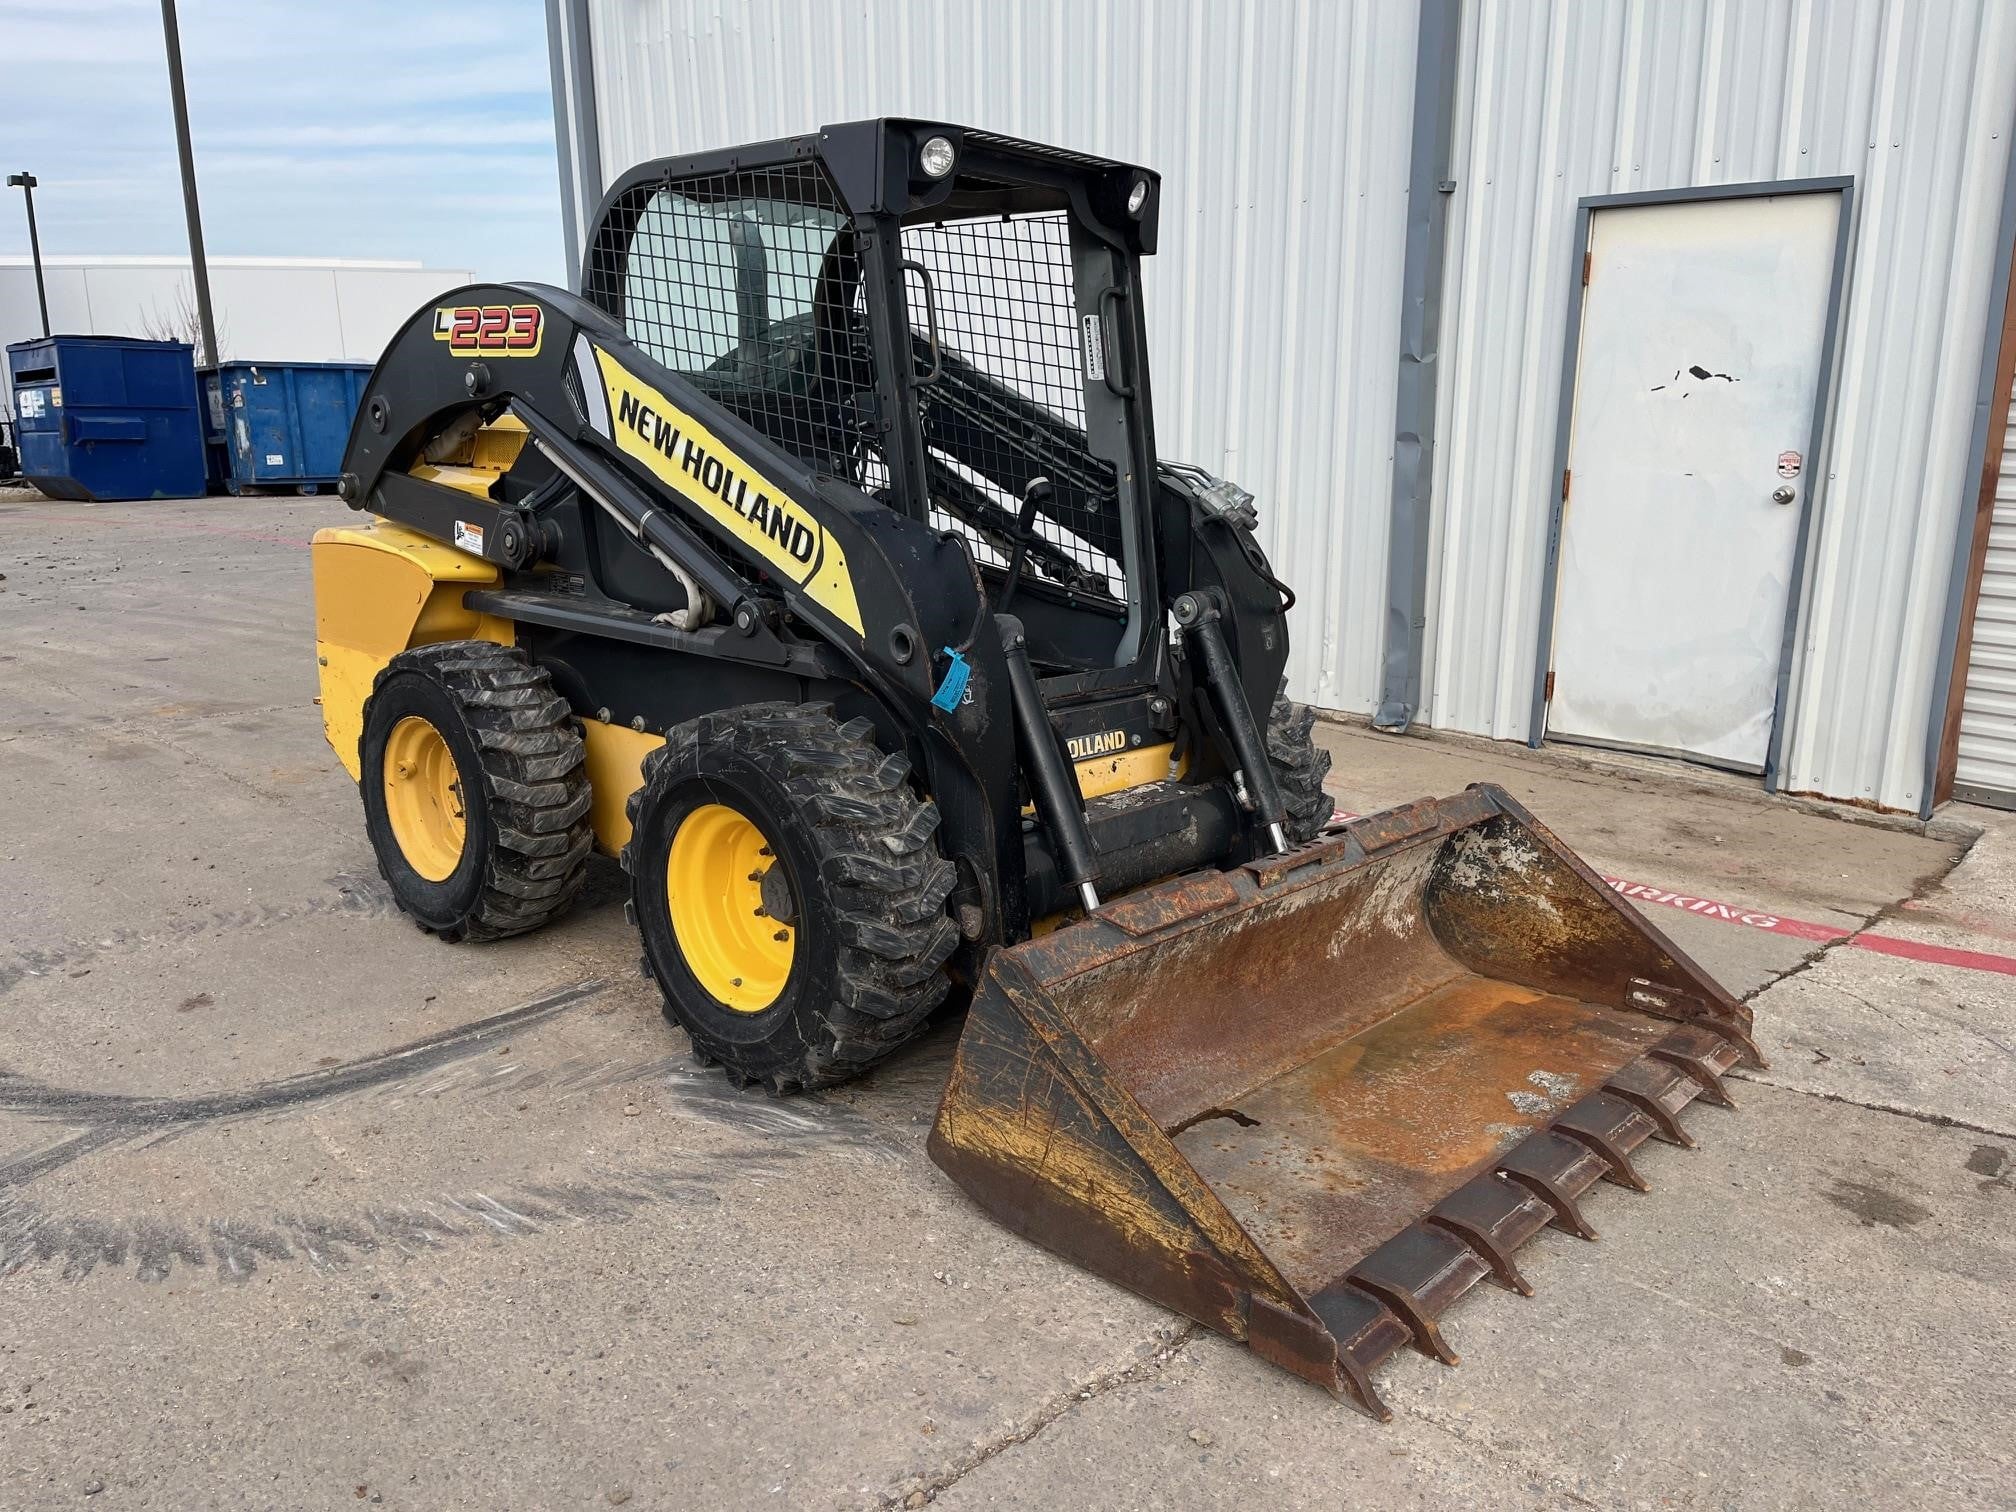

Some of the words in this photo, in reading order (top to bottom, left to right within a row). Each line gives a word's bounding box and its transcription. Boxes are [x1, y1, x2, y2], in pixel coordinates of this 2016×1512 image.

[434, 306, 542, 351] L223
[618, 389, 680, 460] NEW
[681, 437, 815, 564] HOLLAND
[1066, 730, 1126, 759] OLLAND
[1601, 876, 1780, 928] ARKING
